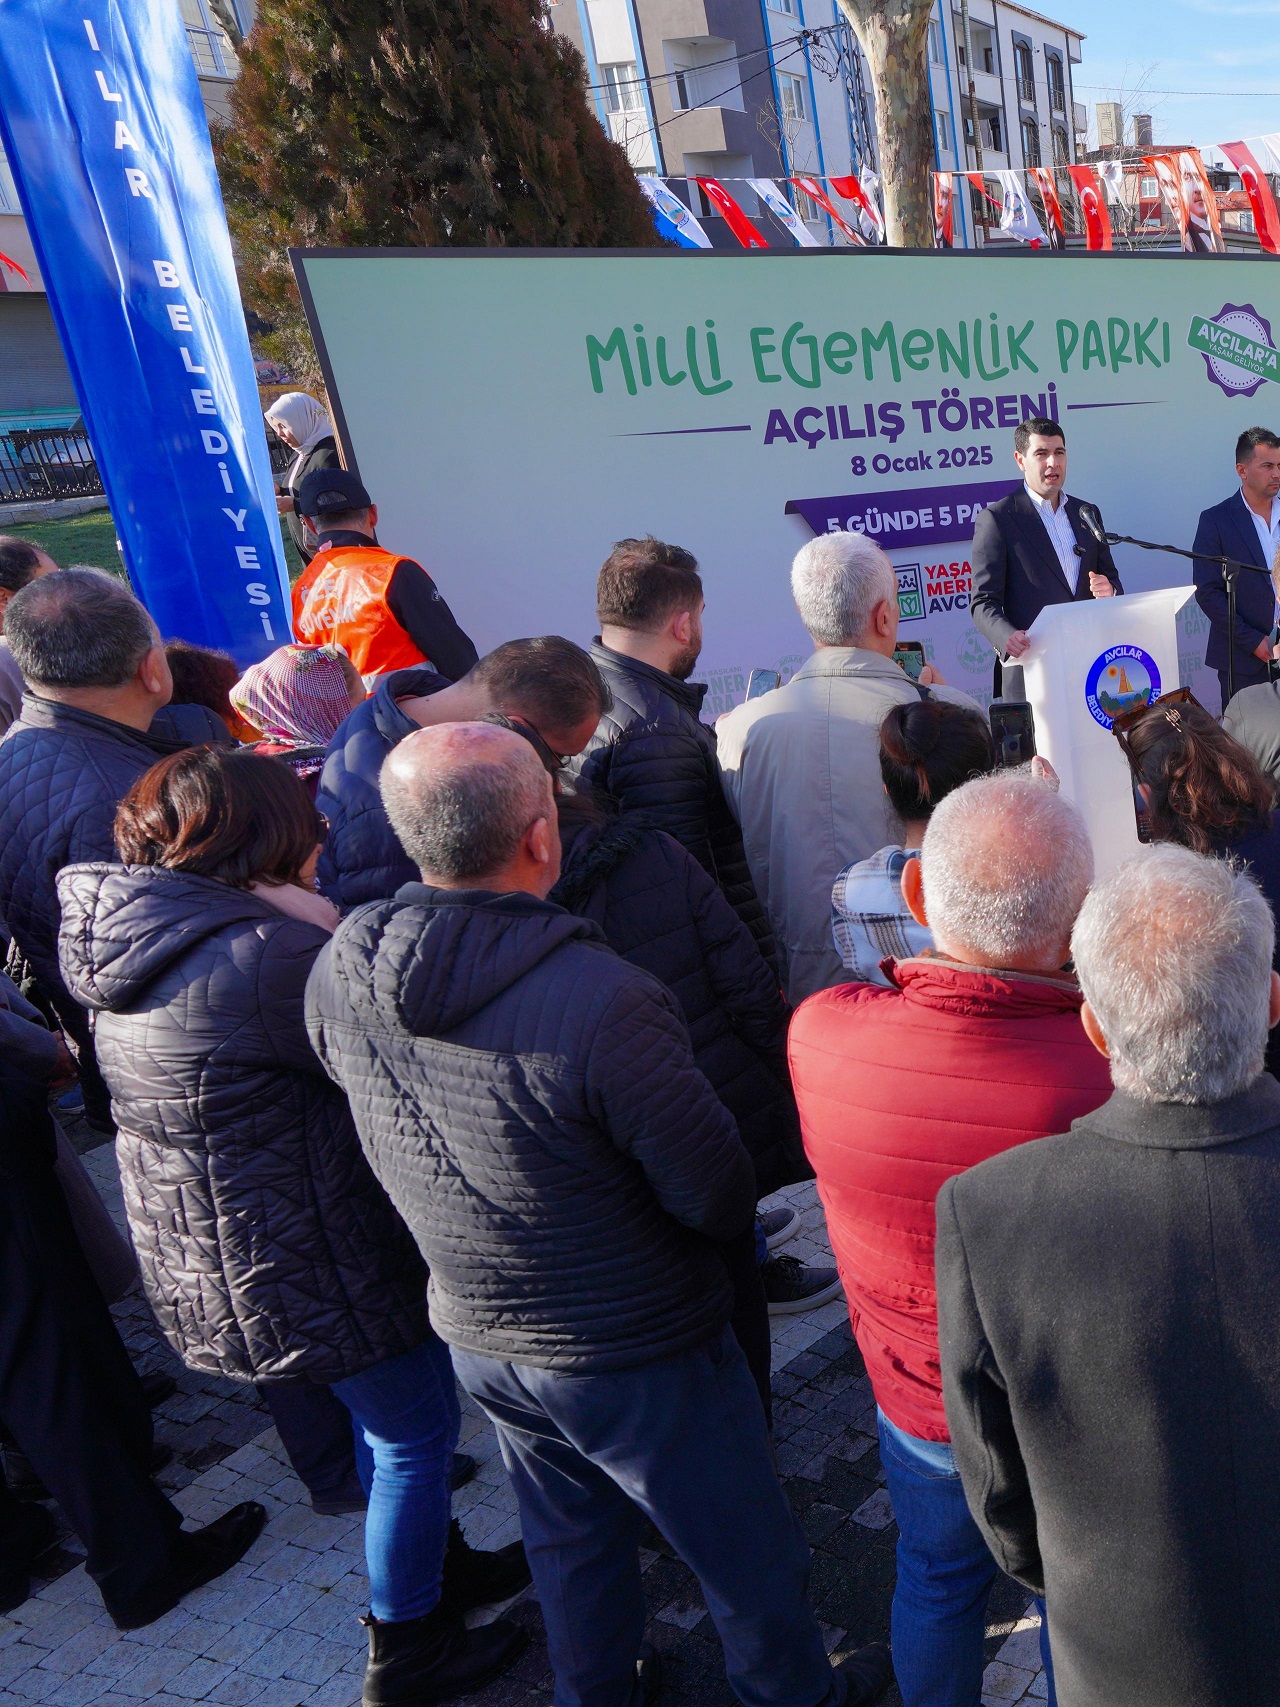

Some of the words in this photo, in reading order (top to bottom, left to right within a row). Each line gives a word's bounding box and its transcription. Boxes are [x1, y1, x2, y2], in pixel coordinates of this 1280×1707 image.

[1056, 316, 1171, 374] PARKI
[1197, 323, 1278, 370] AVCILAR'A
[1208, 342, 1233, 359] YAŞAM
[1234, 355, 1265, 374] GELİYOR
[763, 402, 905, 449] AÇILIŞ
[912, 381, 1060, 434] TÖRENİ
[153, 260, 275, 641] BELEDİYESİ
[850, 455, 867, 476] 8
[872, 450, 932, 474] Ocak
[938, 445, 994, 469] 2025
[827, 516, 840, 535] 5
[846, 507, 934, 535] GÜNDE
[939, 506, 953, 527] 5
[956, 501, 996, 524] PA
[1104, 646, 1143, 664] AVCILAR
[692, 673, 746, 697] ANER
